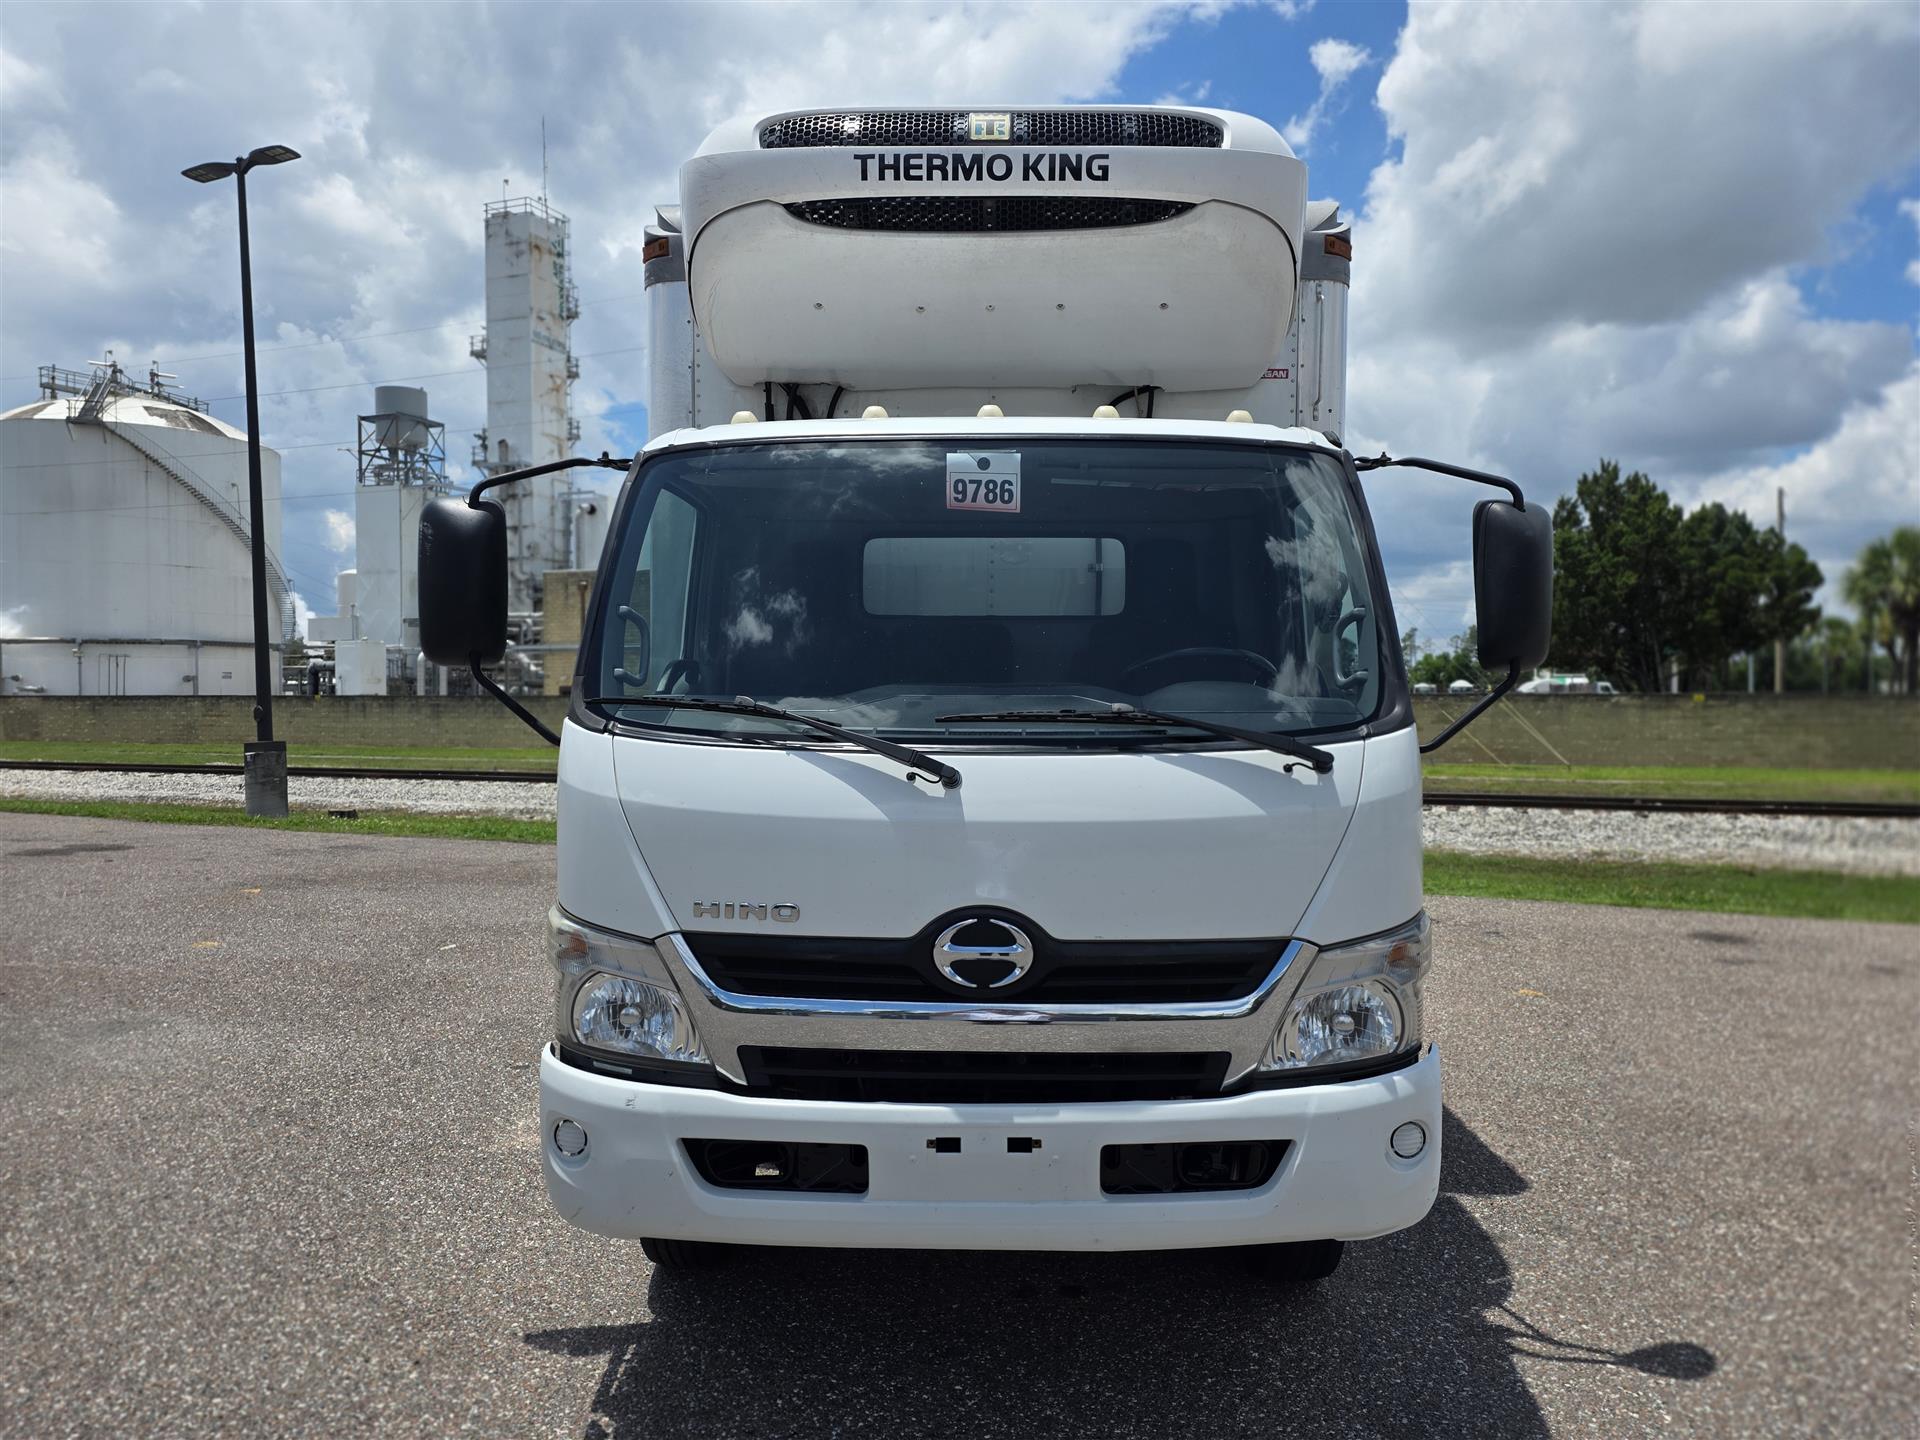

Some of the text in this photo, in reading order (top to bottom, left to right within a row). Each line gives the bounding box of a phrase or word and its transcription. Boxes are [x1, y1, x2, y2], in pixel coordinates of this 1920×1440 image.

[853, 153, 1110, 182] THERMO KING
[953, 478, 1014, 505] 9786
[693, 900, 800, 923] HINO
